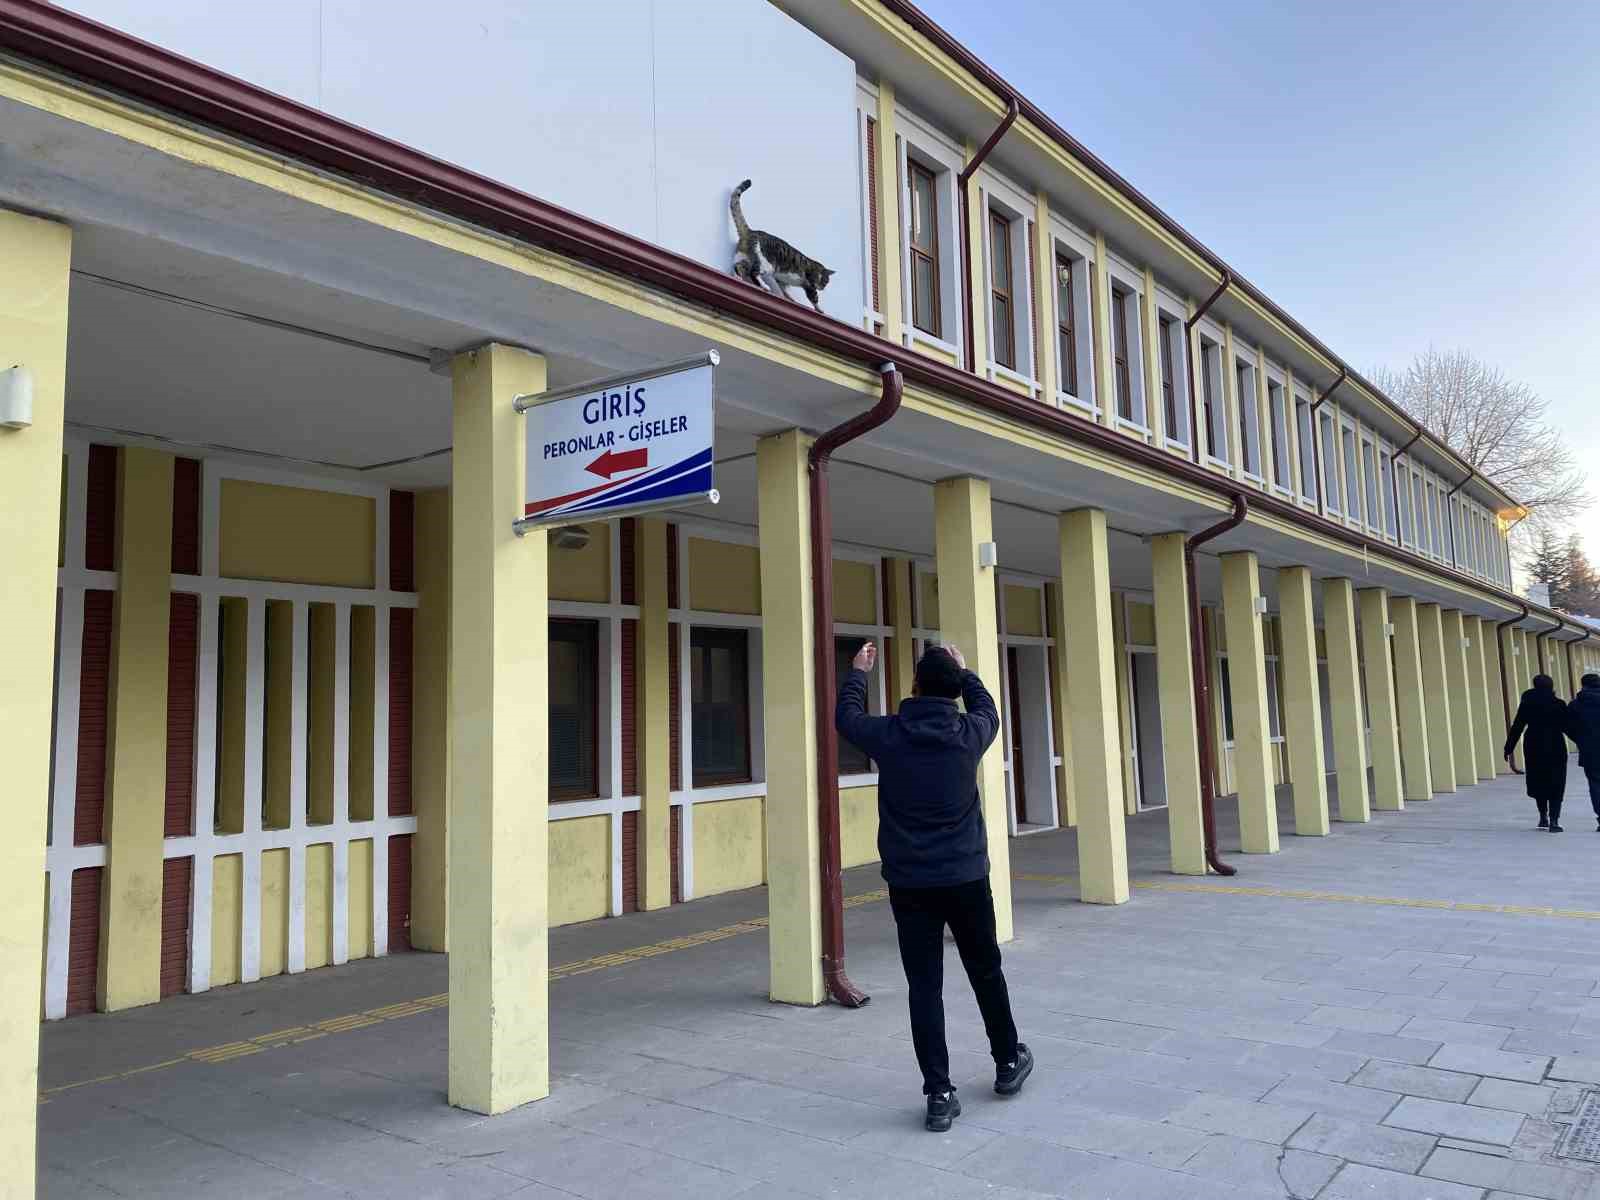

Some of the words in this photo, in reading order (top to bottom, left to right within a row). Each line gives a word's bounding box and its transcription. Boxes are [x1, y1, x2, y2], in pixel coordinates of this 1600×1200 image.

[583, 385, 646, 424] GİRİŞ
[544, 431, 615, 460] PERONLAR
[628, 415, 688, 442] GİŞELER
